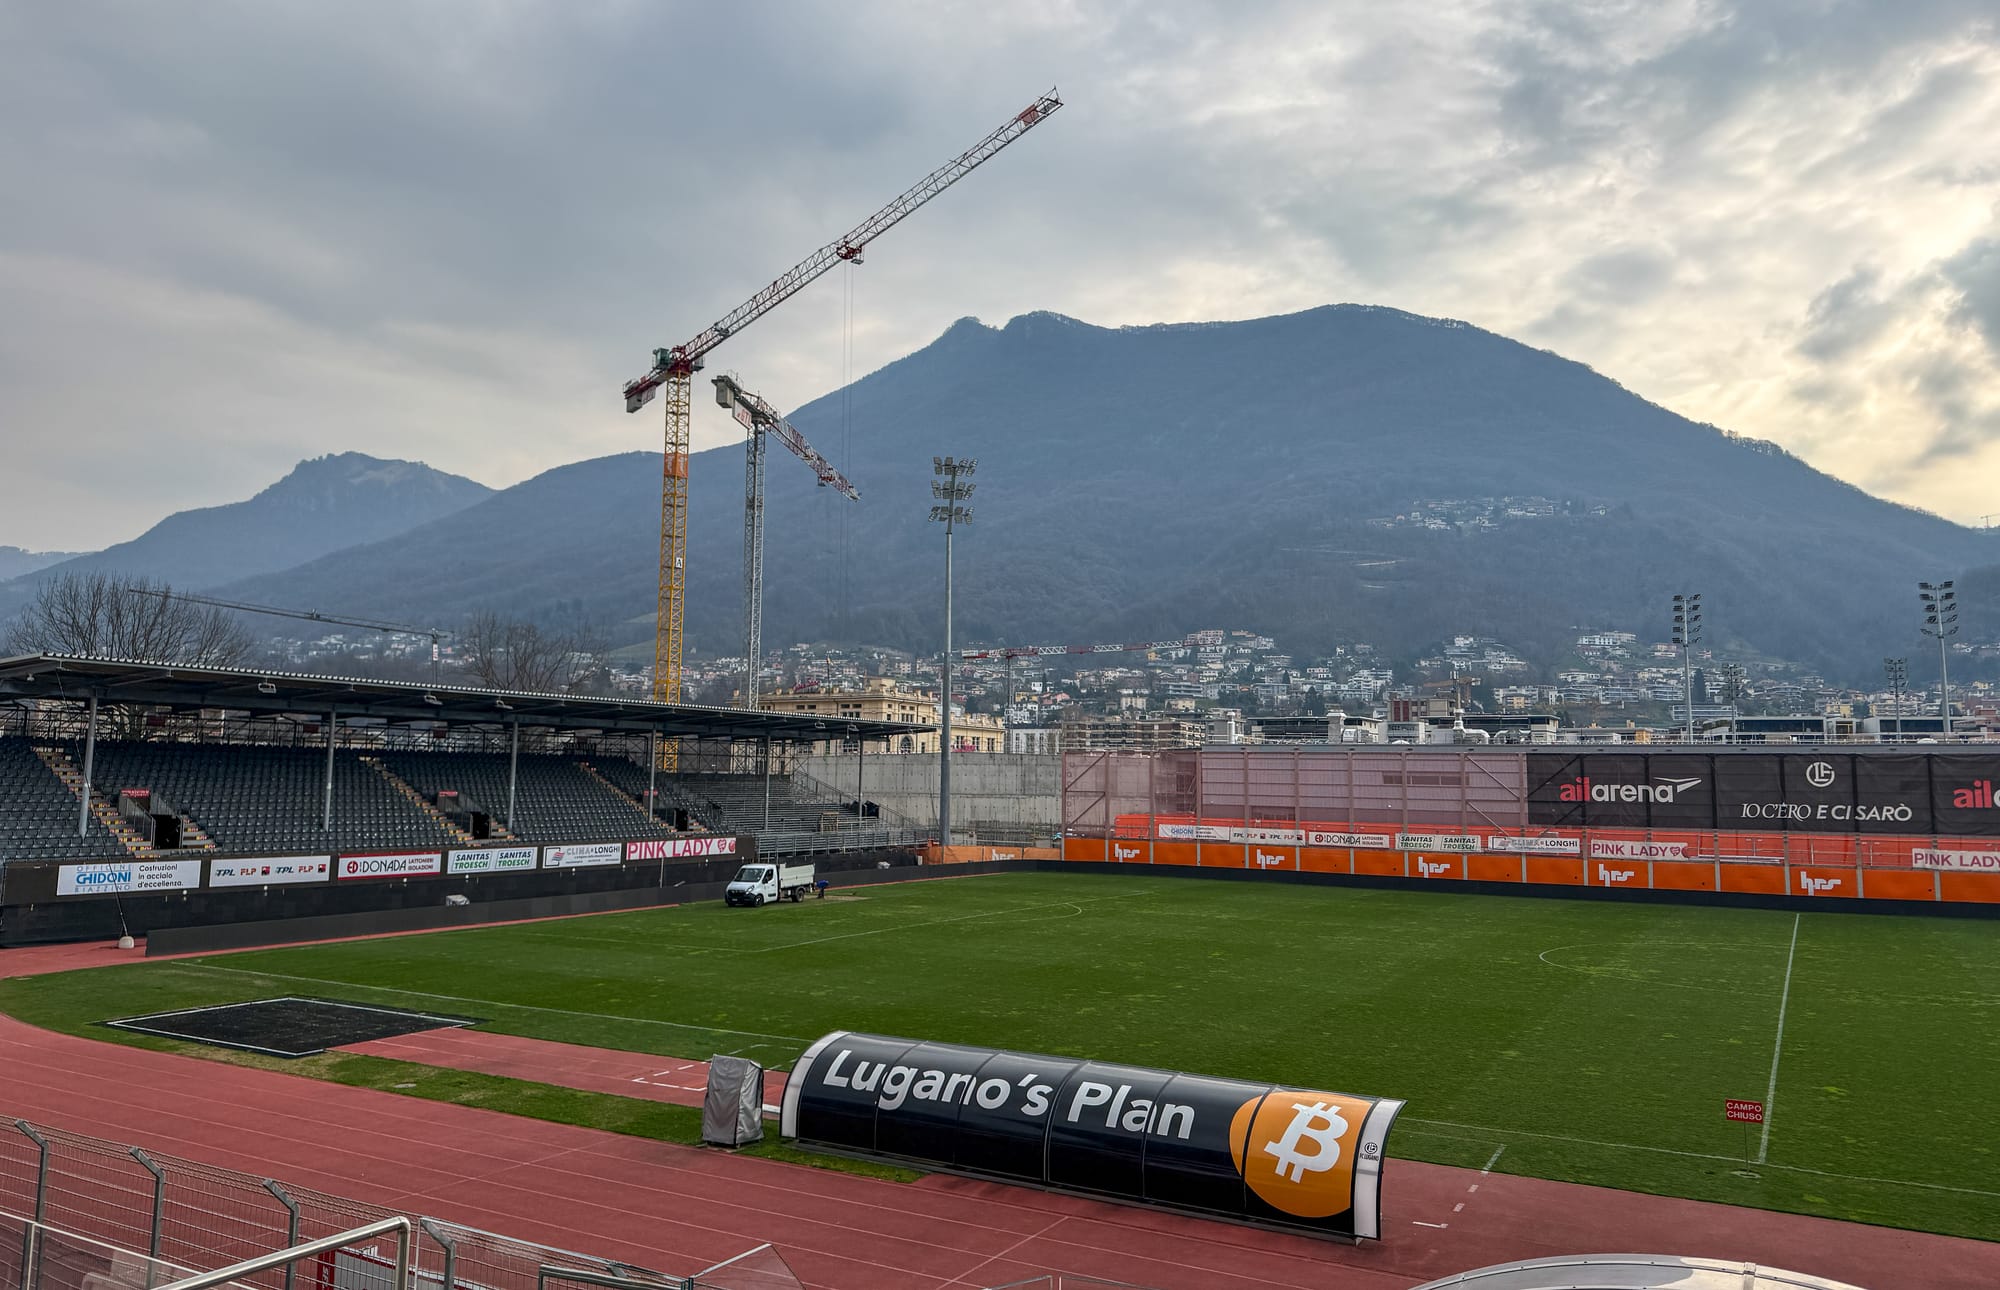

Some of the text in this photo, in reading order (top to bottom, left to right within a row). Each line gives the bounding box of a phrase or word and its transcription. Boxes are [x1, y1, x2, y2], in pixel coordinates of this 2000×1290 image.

[1740, 803, 1760, 818] IO
[1816, 804, 1829, 820] E
[1831, 804, 1852, 820] CI
[1855, 804, 1912, 822] SARÒ
[1326, 834, 1360, 844] DONADA
[627, 838, 714, 860] PINK LADY
[1592, 844, 1668, 857] PINK LADY
[456, 852, 490, 861] SANITAS
[500, 851, 532, 859] SANITAS
[1914, 852, 1952, 866] PINK
[362, 860, 406, 873] DONADA
[454, 861, 488, 869] TROESCH
[498, 859, 530, 867] TROESCH
[215, 868, 236, 876] TPL
[240, 868, 257, 876] FLP
[274, 866, 294, 874] TPL
[76, 872, 131, 884] GHIDONI
[822, 1049, 1196, 1140] Lugano's Plan
[1726, 1102, 1762, 1112] CAMPO
[1727, 1110, 1762, 1120] CHIUSO
